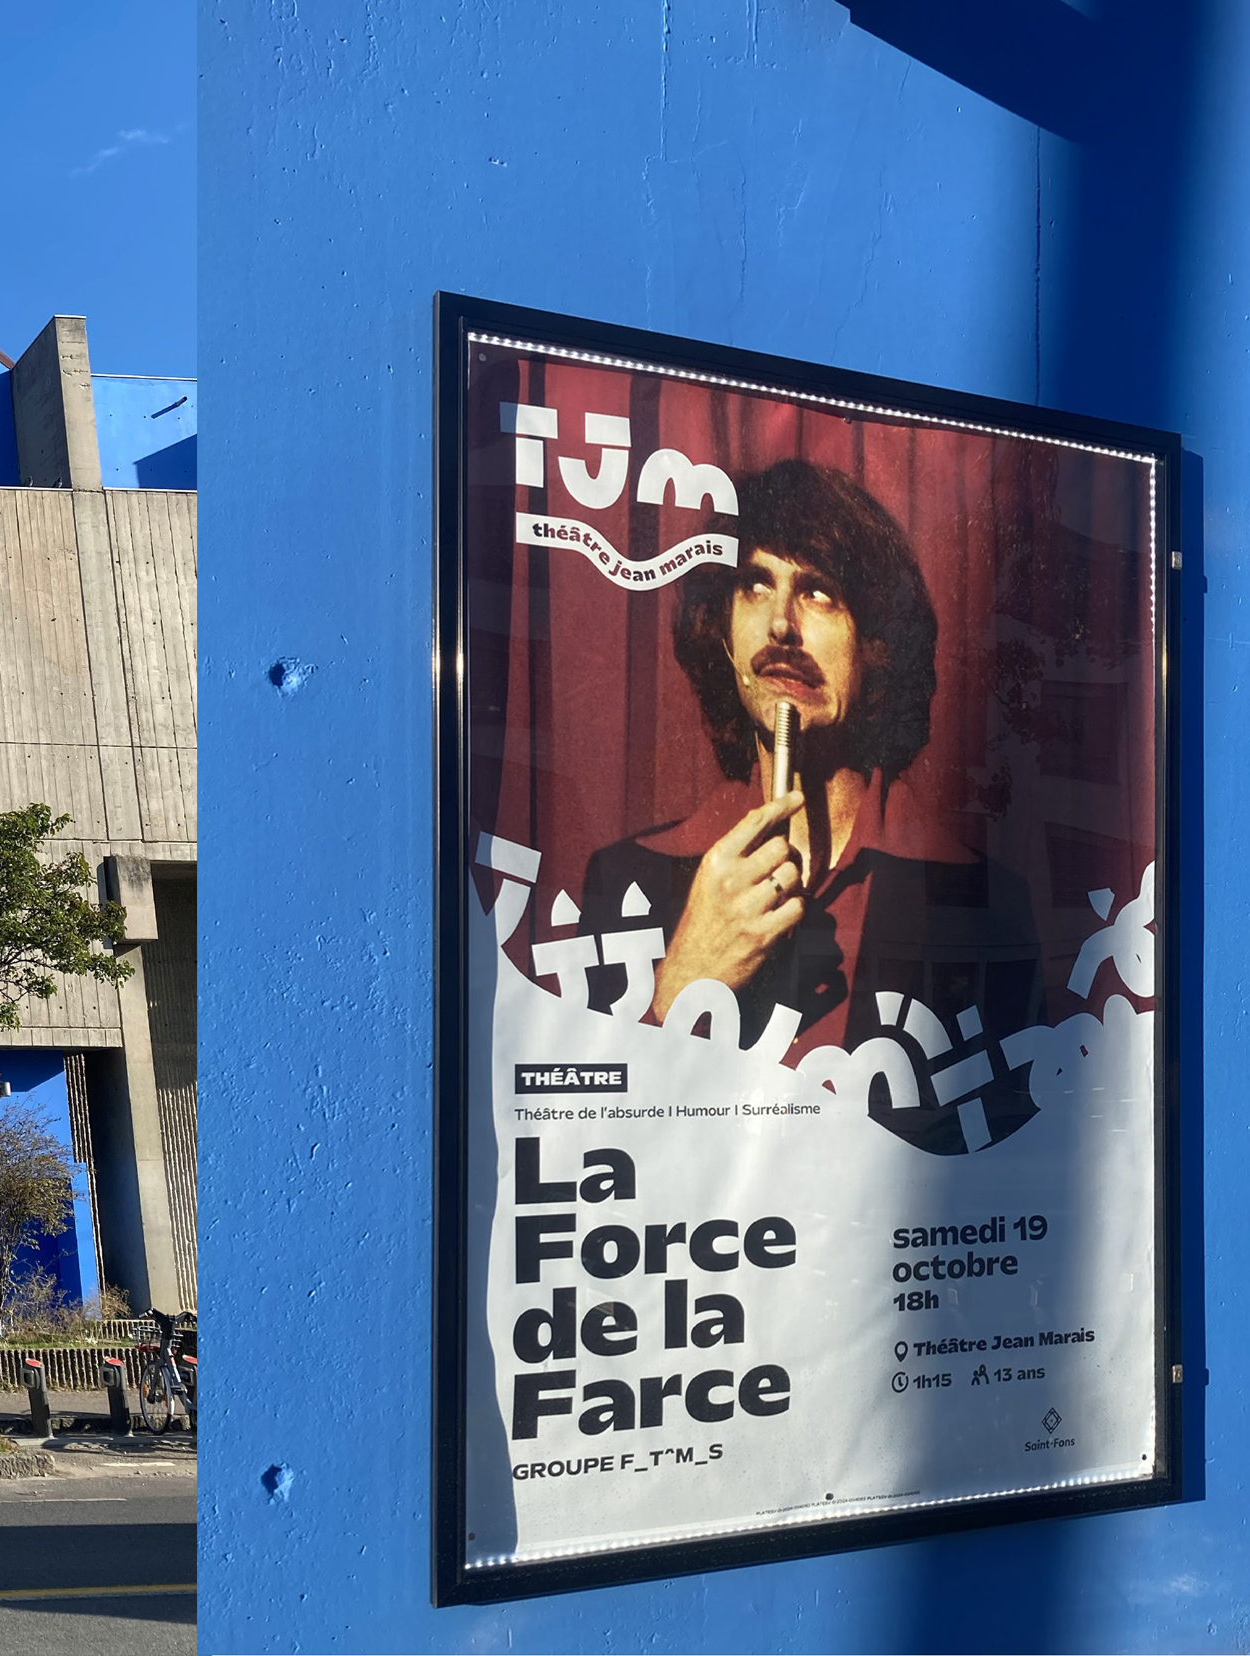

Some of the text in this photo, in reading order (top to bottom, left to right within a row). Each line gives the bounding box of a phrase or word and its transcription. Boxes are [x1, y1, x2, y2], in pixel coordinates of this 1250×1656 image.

[532, 523, 723, 581] théâtre jean marais
[521, 1067, 622, 1086] THÉÂTRE
[515, 1107, 574, 1120] Théâtre
[578, 1107, 597, 1120] de
[600, 1105, 665, 1119] l'absurde
[676, 1105, 730, 1117] Humour
[742, 1103, 821, 1115] Surréalisme
[515, 1137, 636, 1204] La
[893, 1215, 1048, 1248] samedi 19
[515, 1213, 797, 1284] Force
[892, 1251, 1018, 1282] octobre
[893, 1290, 939, 1311] 18h
[513, 1279, 745, 1364] de la
[913, 1328, 1095, 1357] Théâtre Jean Marais
[913, 1367, 1045, 1389] 1h15 13 ans
[511, 1364, 791, 1440] Farce
[1024, 1437, 1075, 1452] Saint-Fons
[512, 1456, 614, 1480] GROUPE
